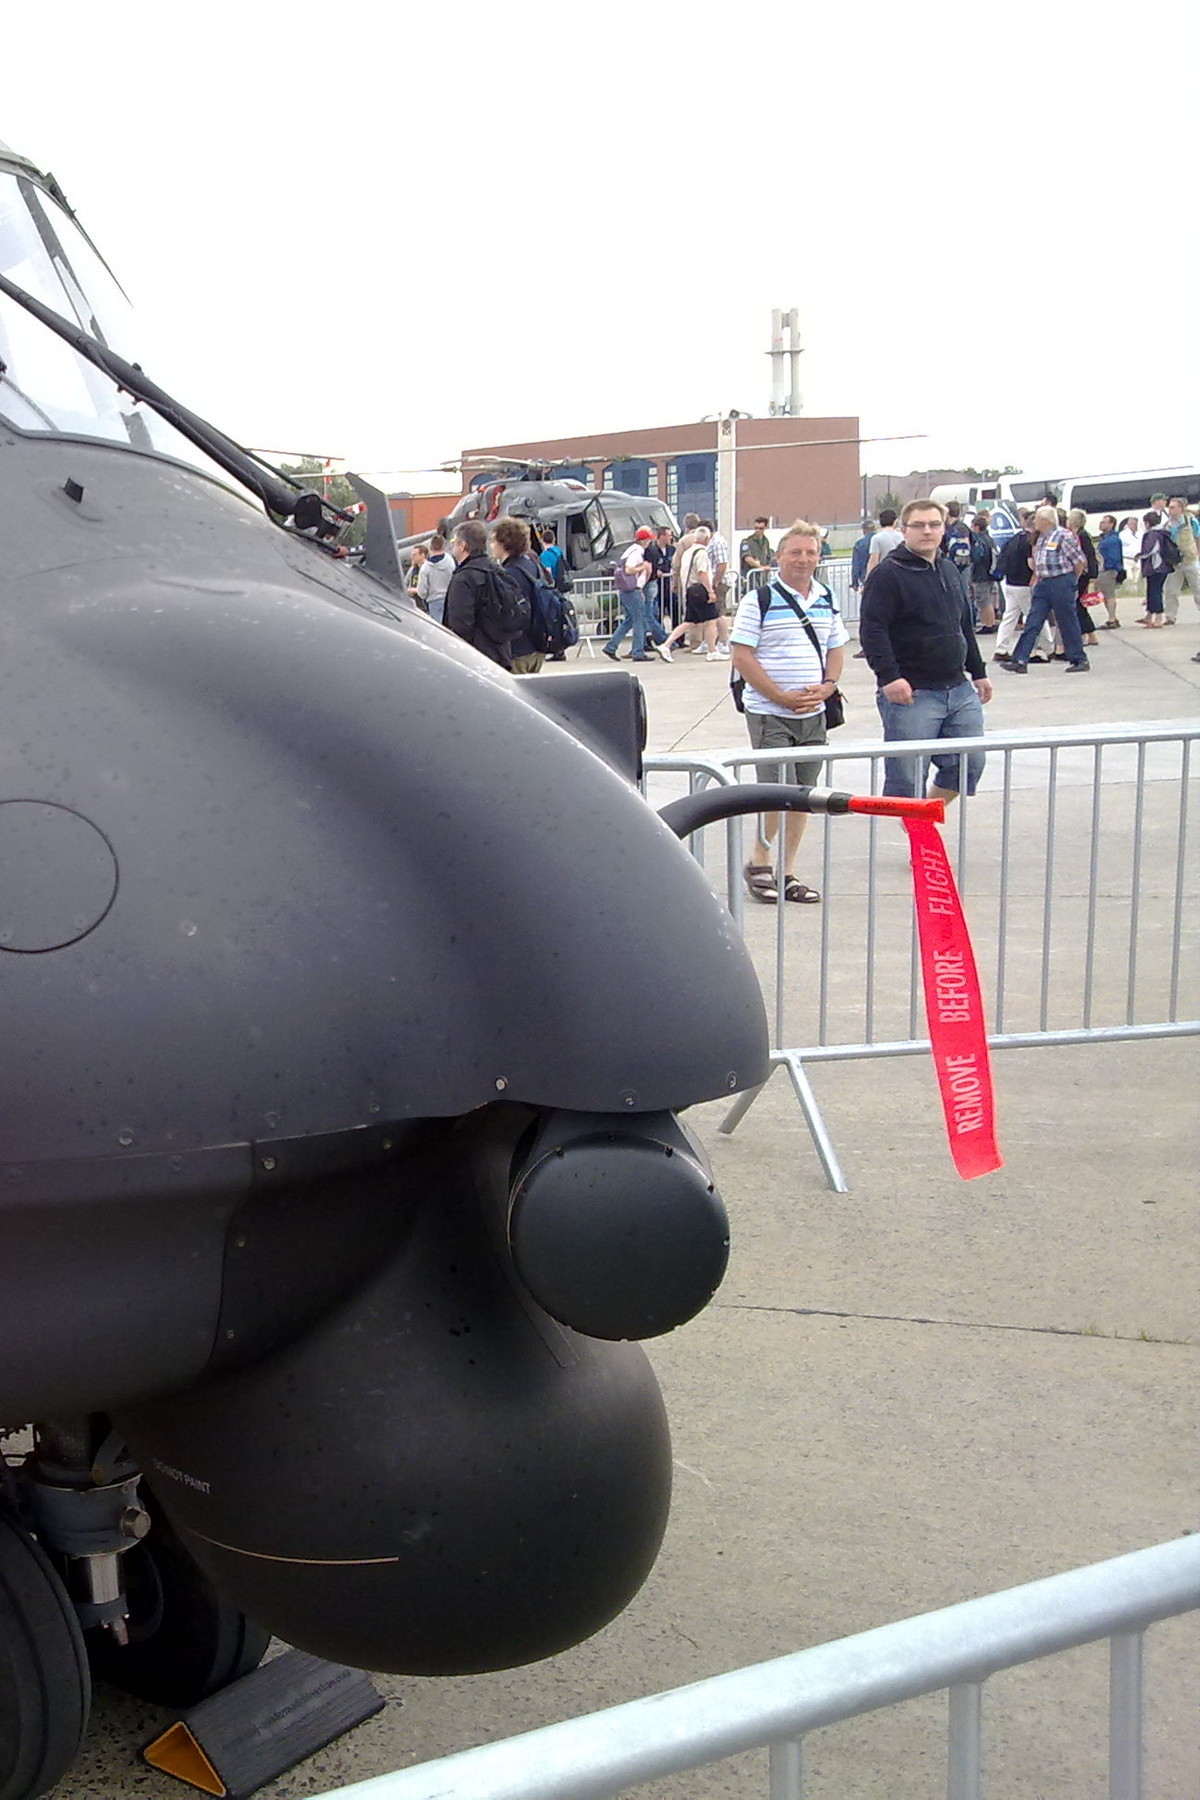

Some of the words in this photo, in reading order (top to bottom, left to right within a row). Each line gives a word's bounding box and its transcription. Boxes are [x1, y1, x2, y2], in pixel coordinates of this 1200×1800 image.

[921, 845, 955, 916] FLIGHT
[933, 950, 971, 1024] BEFORE
[946, 1052, 982, 1135] REMOVE
[183, 1474, 210, 1494] PAINT
